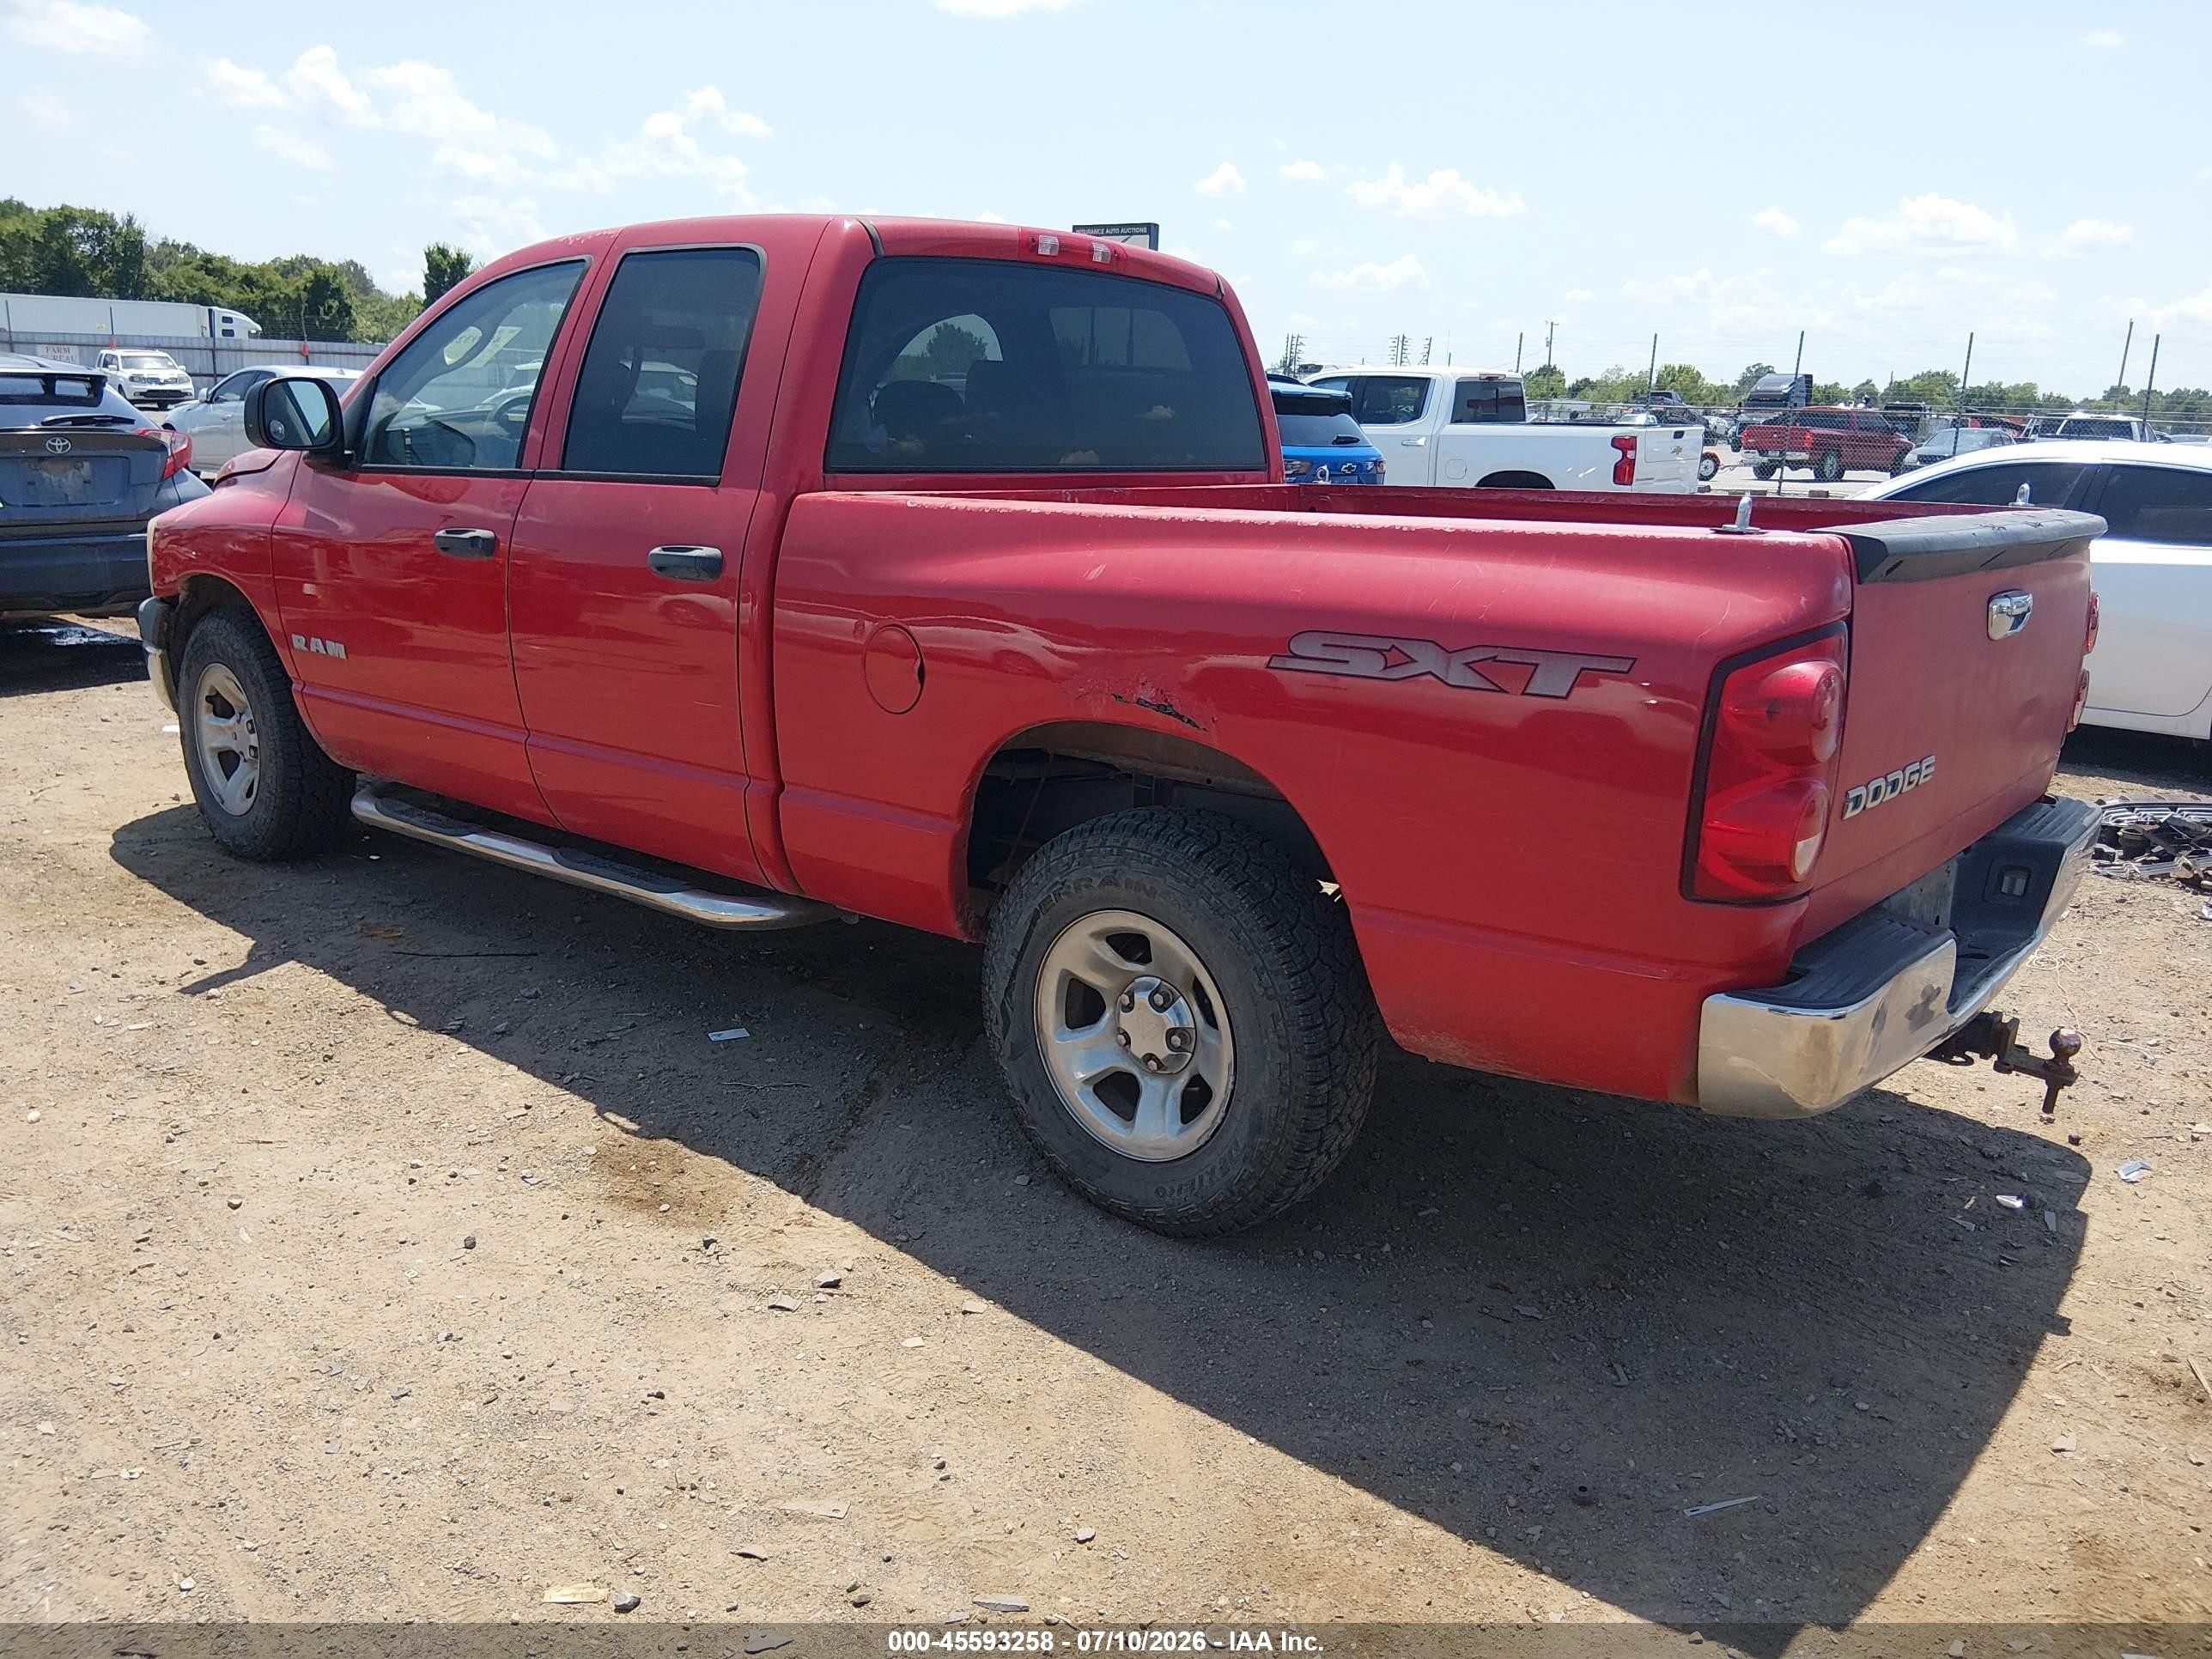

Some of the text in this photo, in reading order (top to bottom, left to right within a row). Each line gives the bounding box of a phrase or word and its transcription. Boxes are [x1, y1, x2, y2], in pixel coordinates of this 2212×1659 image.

[291, 633, 348, 659] RAM
[1265, 630, 1638, 700] SXT
[1842, 755, 1936, 820] DODGE
